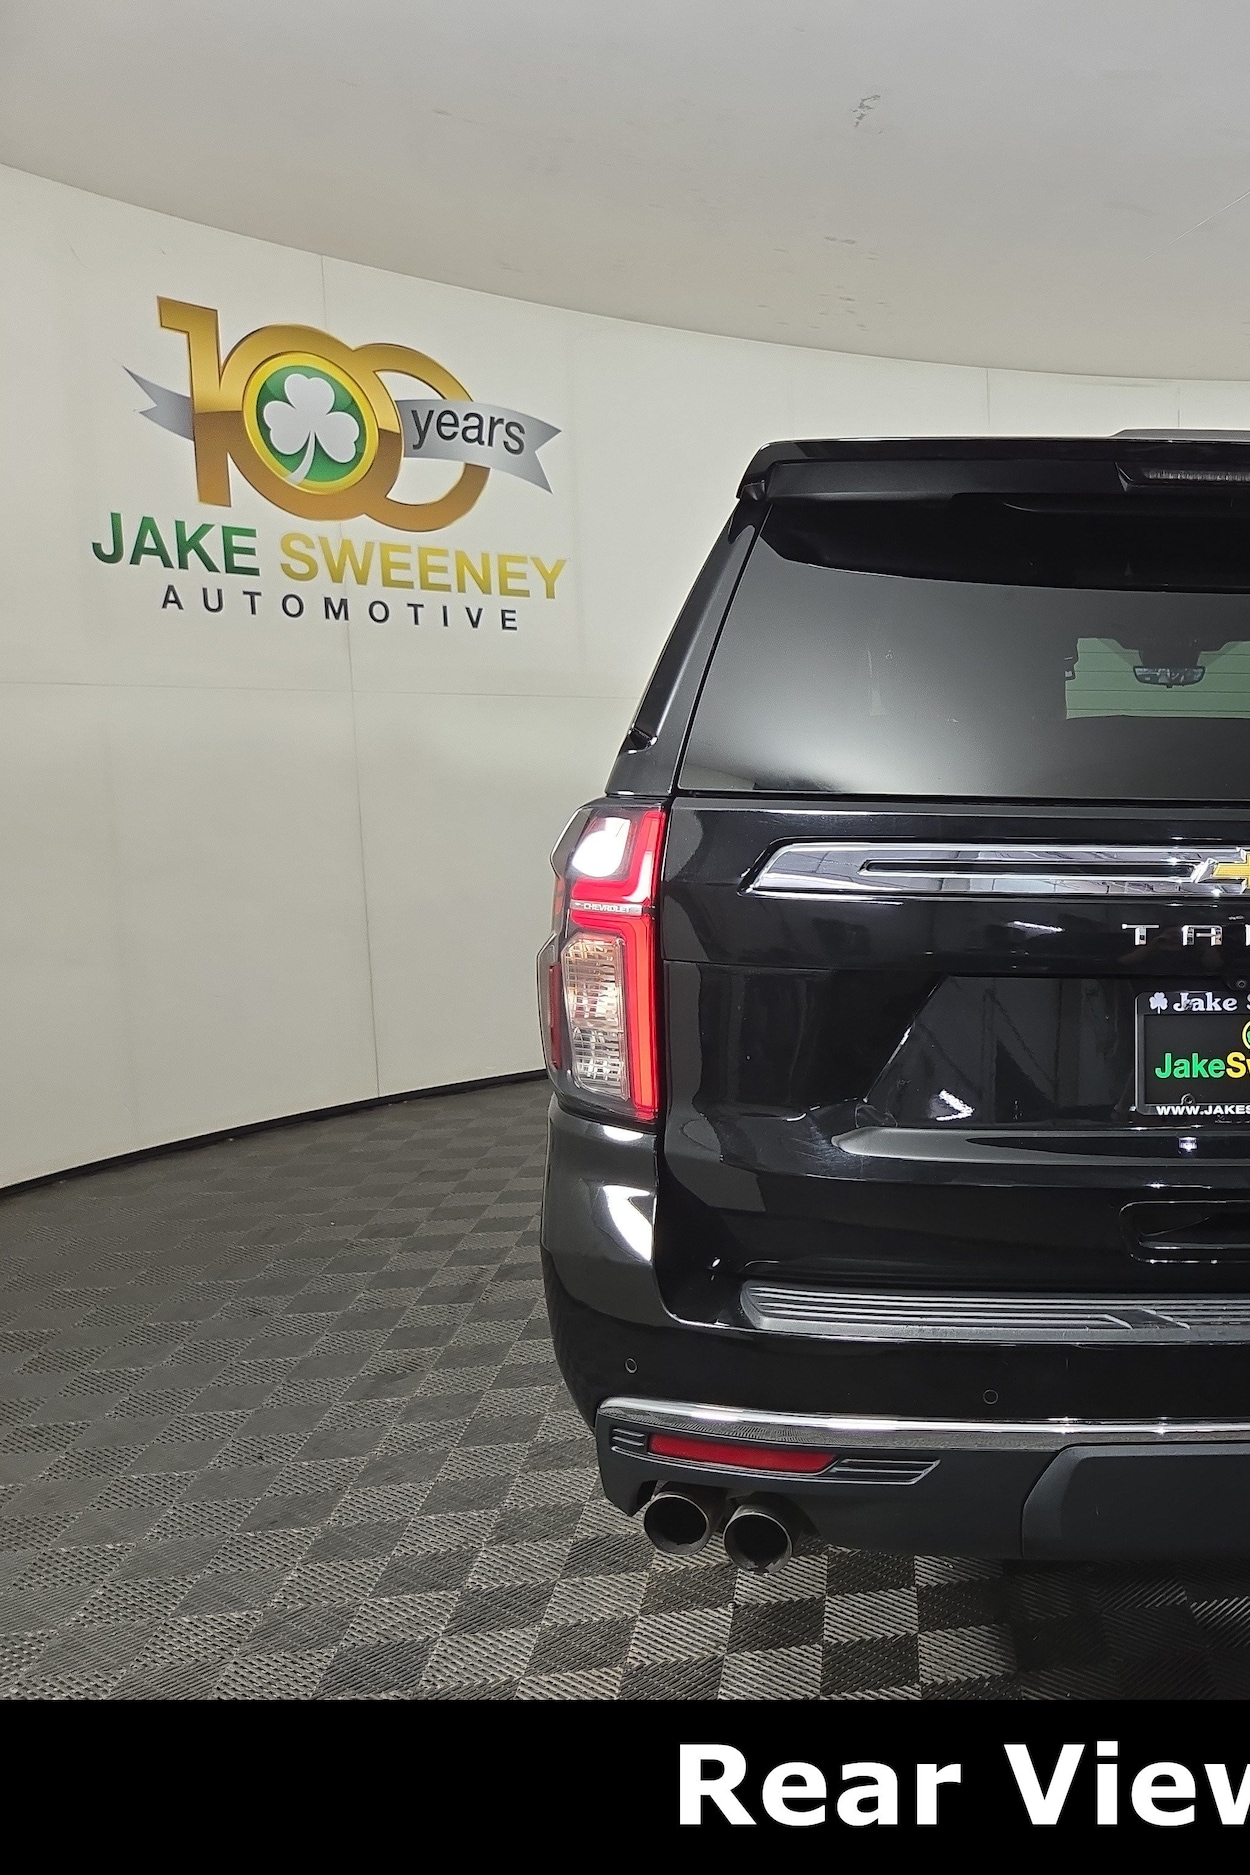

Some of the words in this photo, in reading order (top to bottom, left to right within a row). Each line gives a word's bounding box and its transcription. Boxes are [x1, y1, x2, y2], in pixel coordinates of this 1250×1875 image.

[410, 408, 526, 456] years
[91, 511, 261, 577] JAKE
[279, 531, 568, 599] SWEENEY
[161, 583, 519, 632] AUTOMOTIVE
[583, 901, 631, 913] CHEVROLET
[1172, 991, 1238, 1012] Jake
